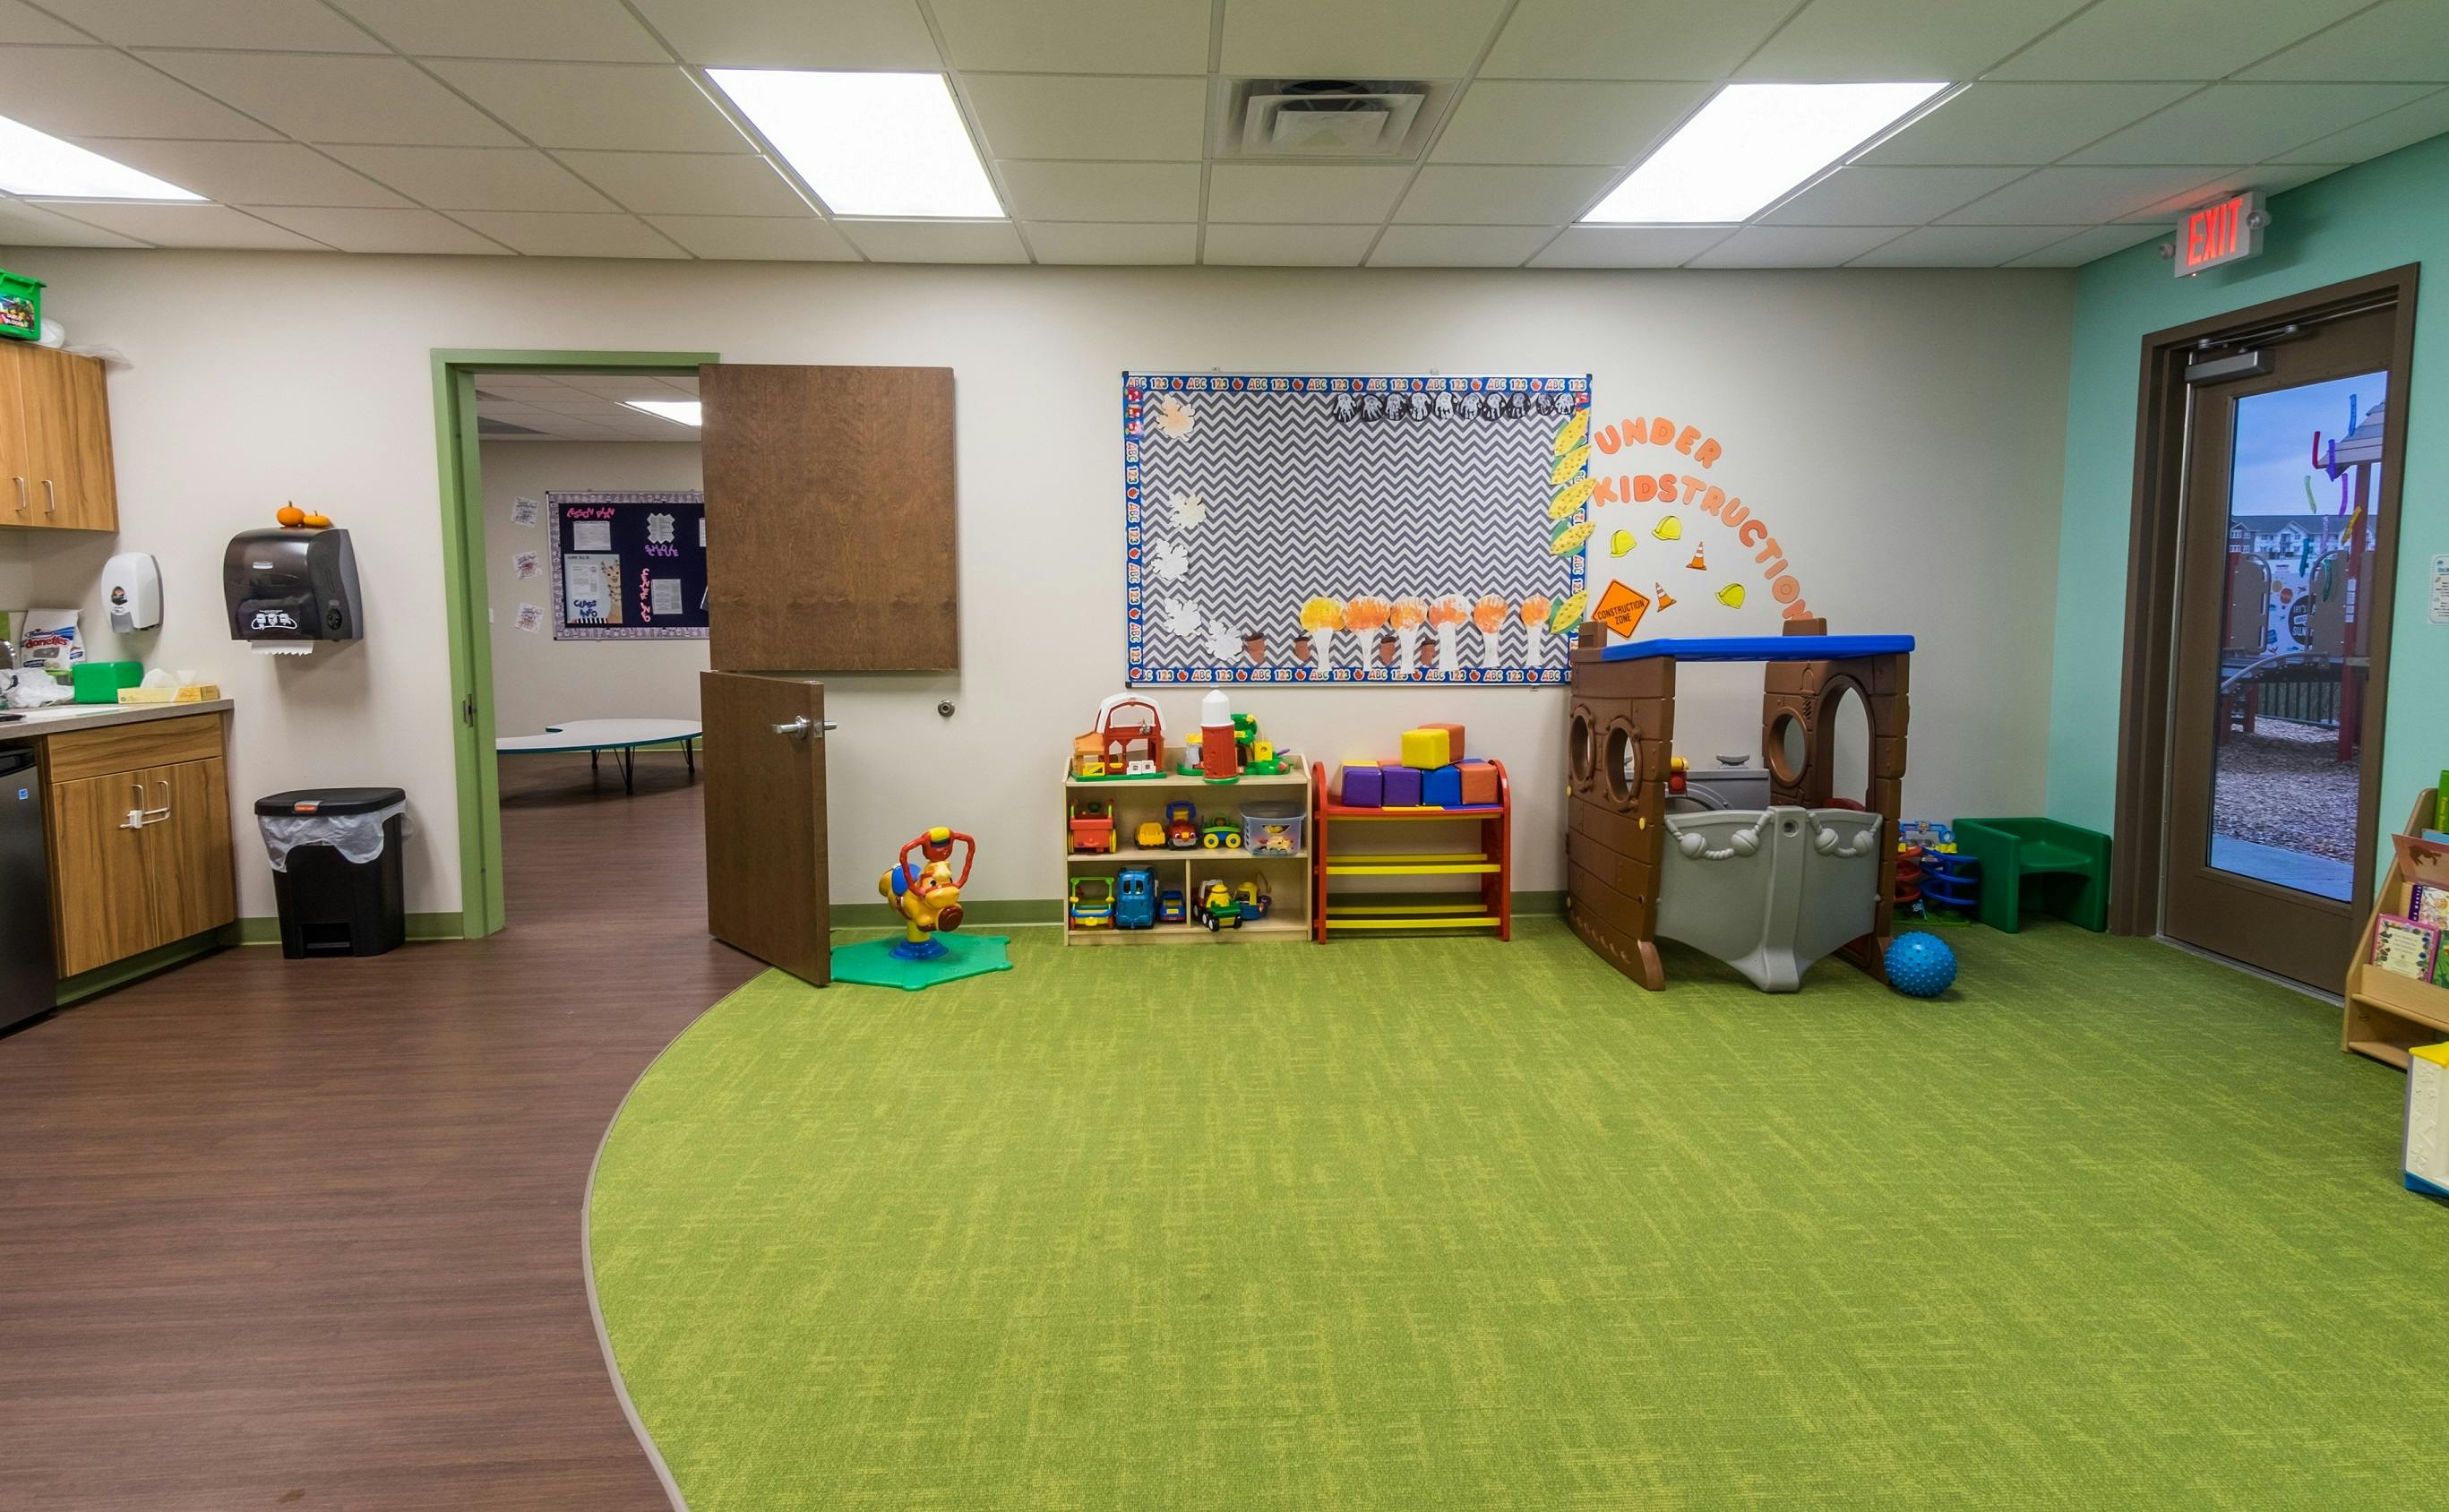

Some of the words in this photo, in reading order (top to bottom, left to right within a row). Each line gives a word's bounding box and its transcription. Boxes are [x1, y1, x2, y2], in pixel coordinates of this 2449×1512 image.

[2187, 197, 2243, 266] EXIT
[1152, 378, 1168, 389] 123
[1188, 378, 1206, 389] ABC
[1211, 378, 1228, 389] 123
[1248, 378, 1267, 389] ABC
[1272, 378, 1288, 389] 123
[1308, 378, 1327, 389] ABC
[1332, 378, 1349, 389] 123
[1367, 380, 1387, 391] ABC
[1390, 380, 1408, 391] 123
[1427, 380, 1446, 391] ABC
[1451, 380, 1467, 391] 123
[1487, 380, 1506, 391] ABC
[1510, 380, 1526, 391] 123
[1545, 380, 1564, 391] ABC
[1569, 380, 1586, 391] 123
[1127, 442, 1139, 462] ABC
[1594, 417, 1722, 468] UNDER
[1128, 466, 1139, 485] 123
[596, 507, 615, 519] PLAN
[1129, 502, 1139, 523] ABC
[1129, 527, 1140, 545] 123
[1130, 563, 1140, 584] ABC
[1573, 554, 1584, 574] ABC
[573, 599, 597, 608] CLASS
[1130, 587, 1140, 605] 123
[580, 608, 597, 617] INFO
[1597, 599, 1645, 620] CONSTRUCTION
[1615, 613, 1631, 624] ZONE
[25, 636, 68, 649] donettes
[1130, 623, 1141, 643] ABC
[1130, 646, 1141, 665] 123
[1157, 669, 1173, 681] 123
[1192, 669, 1211, 681] ABC
[1216, 669, 1233, 681] 123
[1251, 669, 1270, 681] ABC
[1276, 669, 1292, 681] 123
[1334, 669, 1351, 681] 123
[1369, 670, 1388, 681] ABC
[1449, 670, 1465, 681] 123
[1483, 670, 1503, 681] ABC
[1507, 670, 1523, 681] 123
[1541, 670, 1560, 681] ABC
